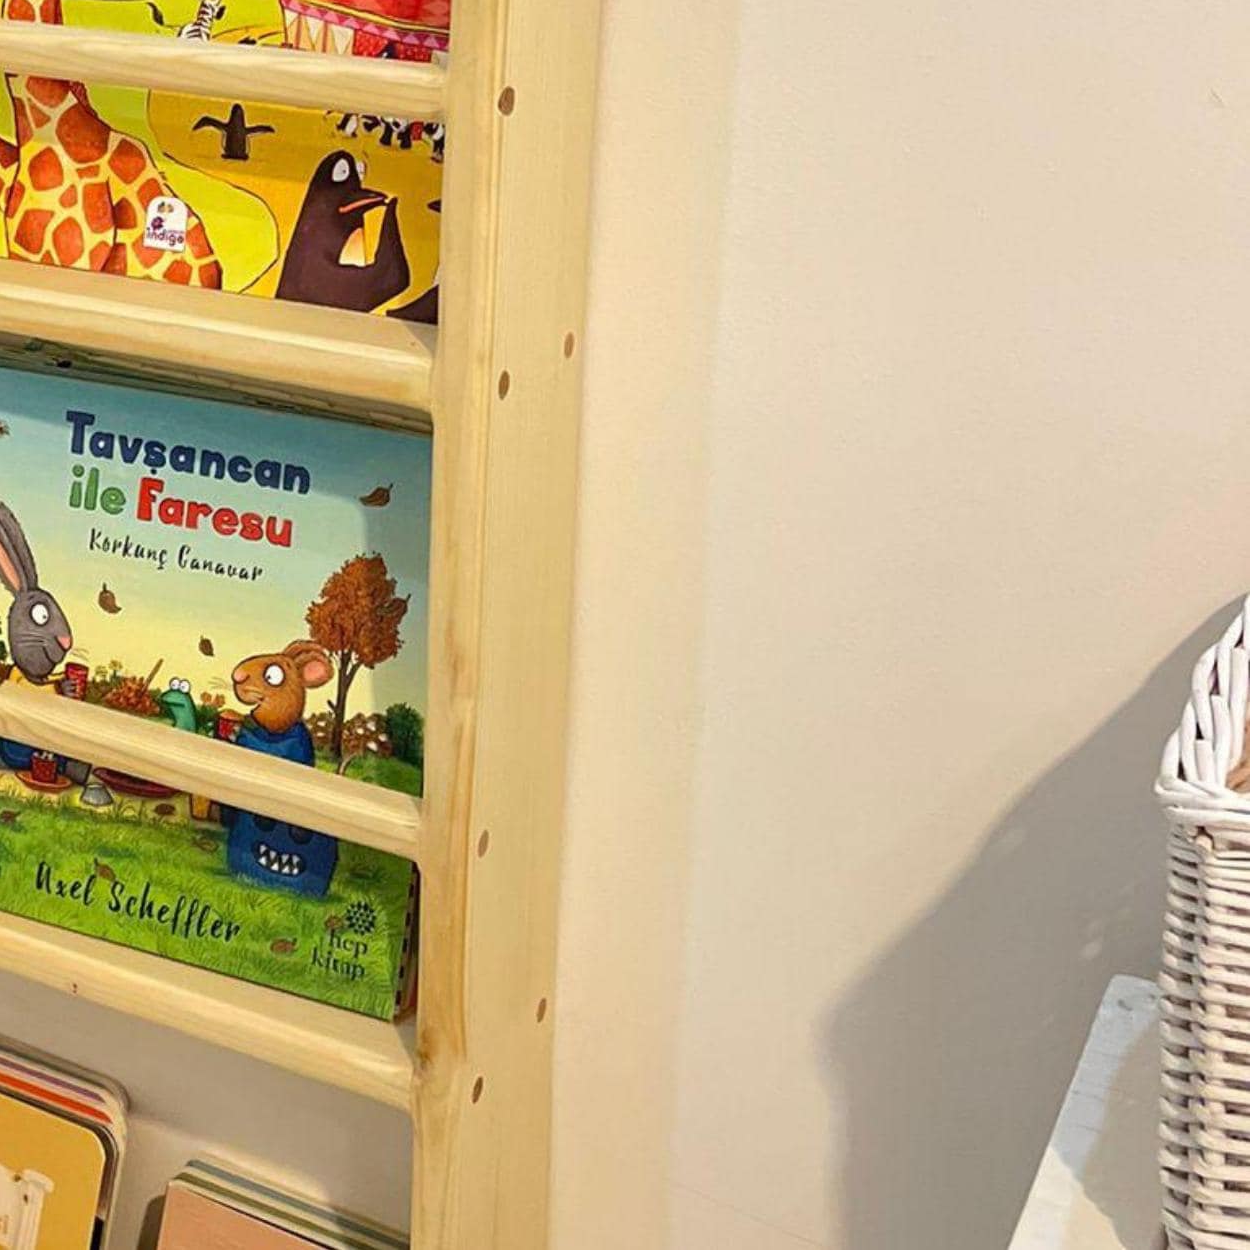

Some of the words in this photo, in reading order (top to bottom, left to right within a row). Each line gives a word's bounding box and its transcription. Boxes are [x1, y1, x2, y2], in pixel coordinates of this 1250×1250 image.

[65, 409, 312, 495] Tavşancan
[68, 465, 127, 516] ile
[136, 476, 294, 549] Faresu
[89, 528, 168, 570] Korkunç
[178, 544, 264, 583] Canavar
[36, 860, 97, 907] Axel
[107, 880, 241, 943] Scheffler
